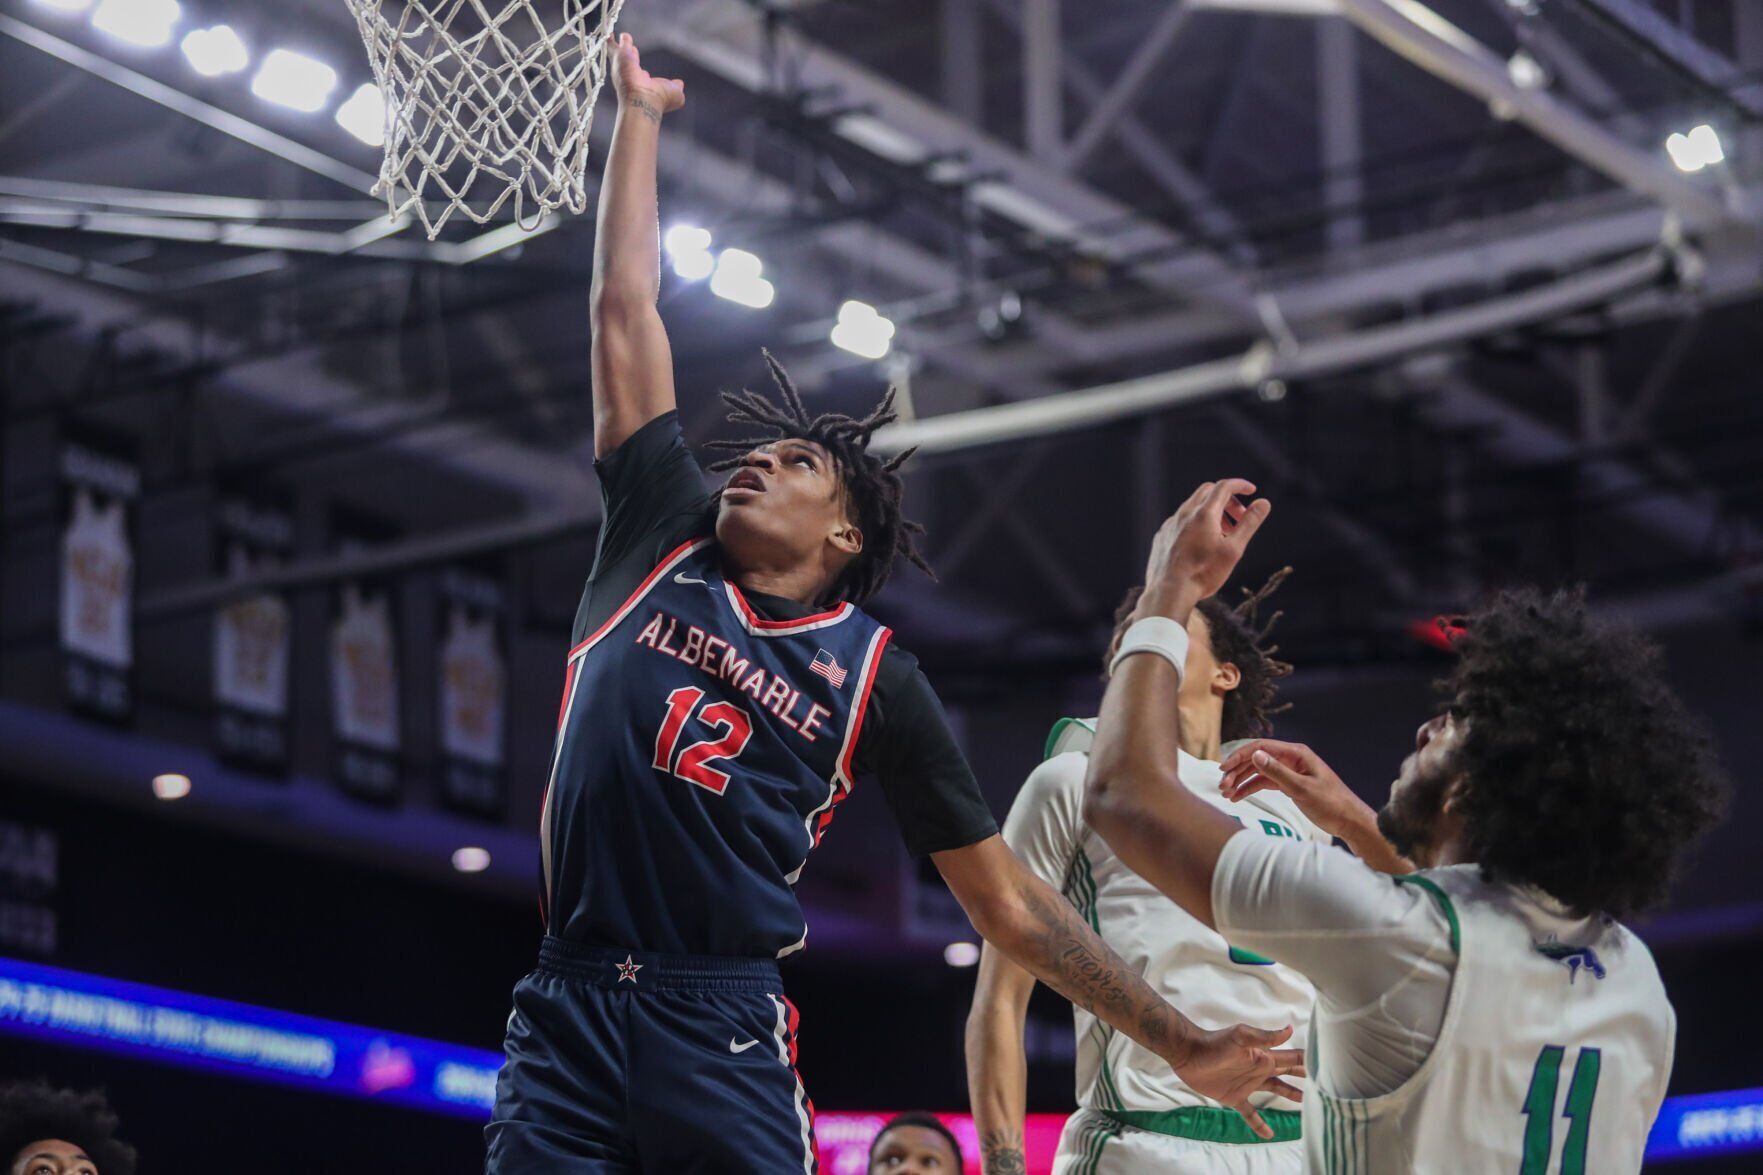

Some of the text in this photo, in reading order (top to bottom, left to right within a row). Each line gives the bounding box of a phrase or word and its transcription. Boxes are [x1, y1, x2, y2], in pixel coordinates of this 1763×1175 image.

[635, 611, 832, 743] ALBEMARLE
[651, 685, 754, 797] 12
[1519, 1044, 1602, 1175] 11
